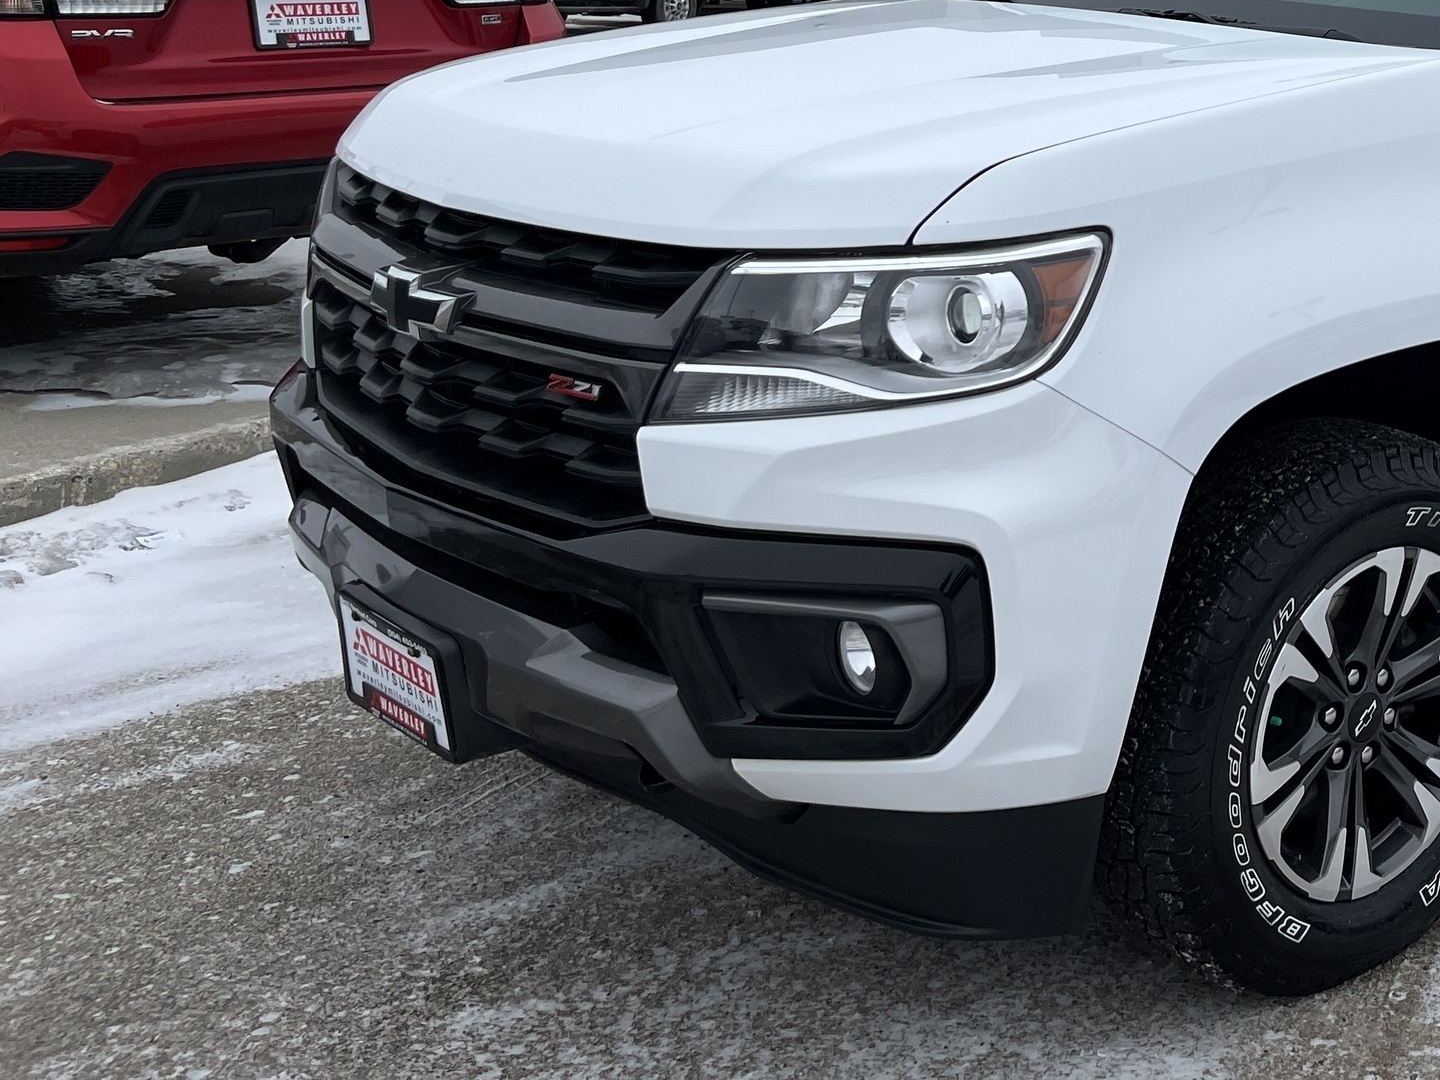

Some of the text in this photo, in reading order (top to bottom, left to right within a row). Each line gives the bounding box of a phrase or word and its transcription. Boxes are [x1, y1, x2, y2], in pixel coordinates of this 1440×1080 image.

[283, 3, 357, 16] WAVERLEY
[286, 16, 360, 26] MITSUBISHI
[298, 31, 347, 41] WAVERLEY
[546, 373, 602, 402] Z71
[366, 635, 433, 693] WAVERLEY
[371, 659, 439, 713] MITSUBISHI
[379, 695, 425, 735] WAVERLEY
[1227, 596, 1311, 944] BFGoodrich
